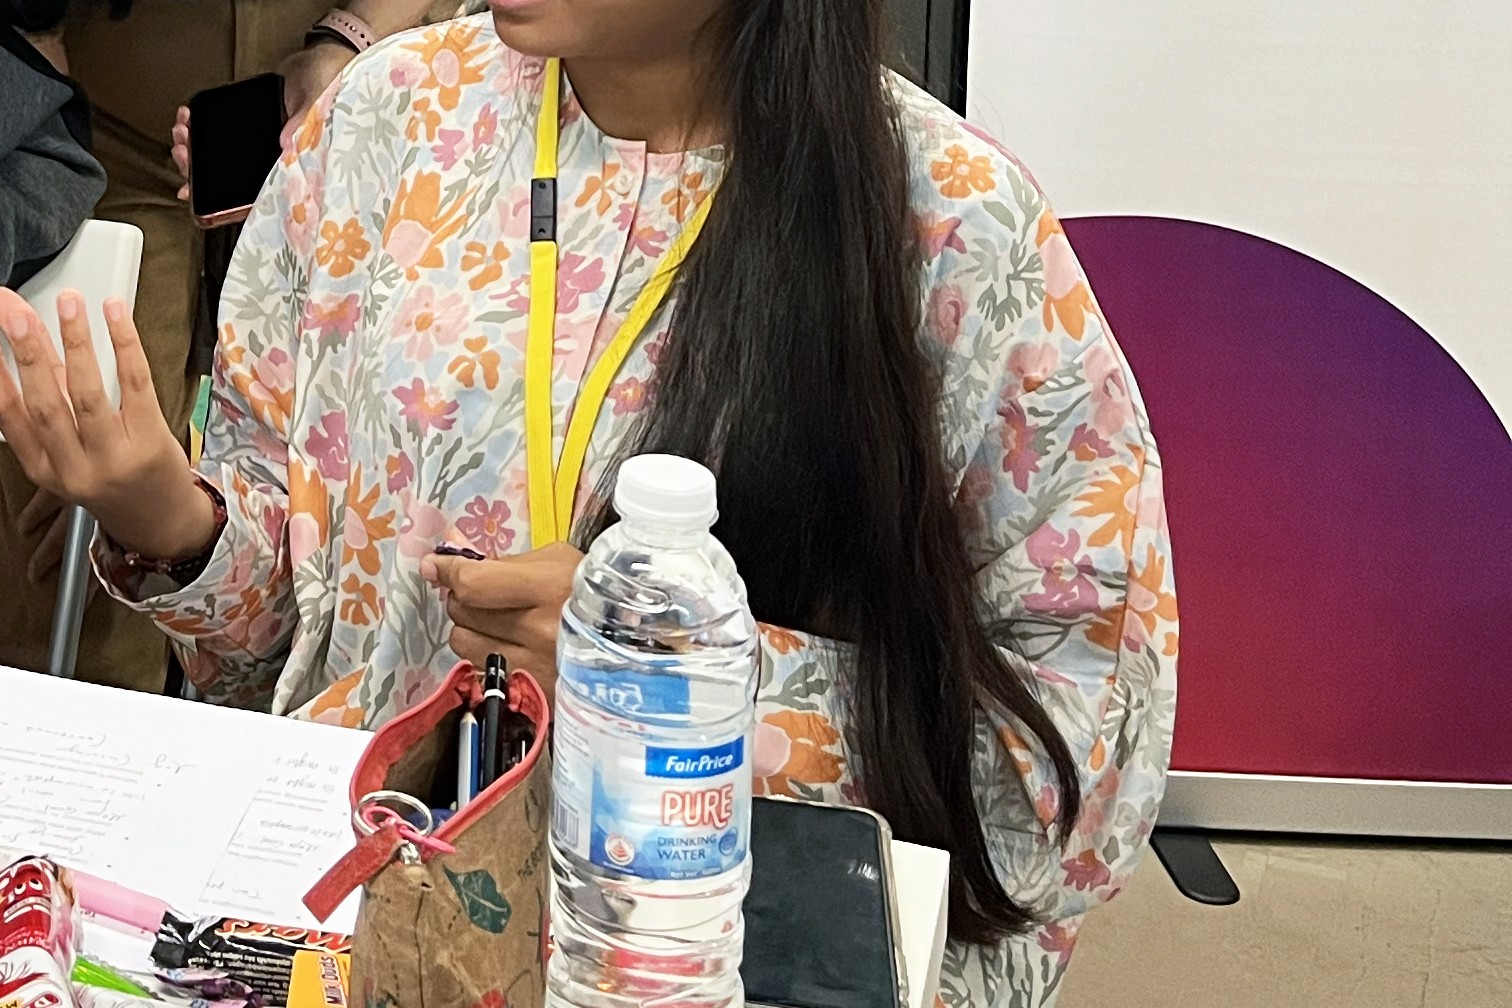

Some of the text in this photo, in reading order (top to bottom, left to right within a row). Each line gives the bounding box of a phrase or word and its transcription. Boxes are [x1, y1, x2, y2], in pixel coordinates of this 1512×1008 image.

[665, 754, 734, 773] FairPrice
[662, 783, 734, 830] PURE
[657, 834, 717, 847] DRINKING
[657, 848, 706, 862] WATER
